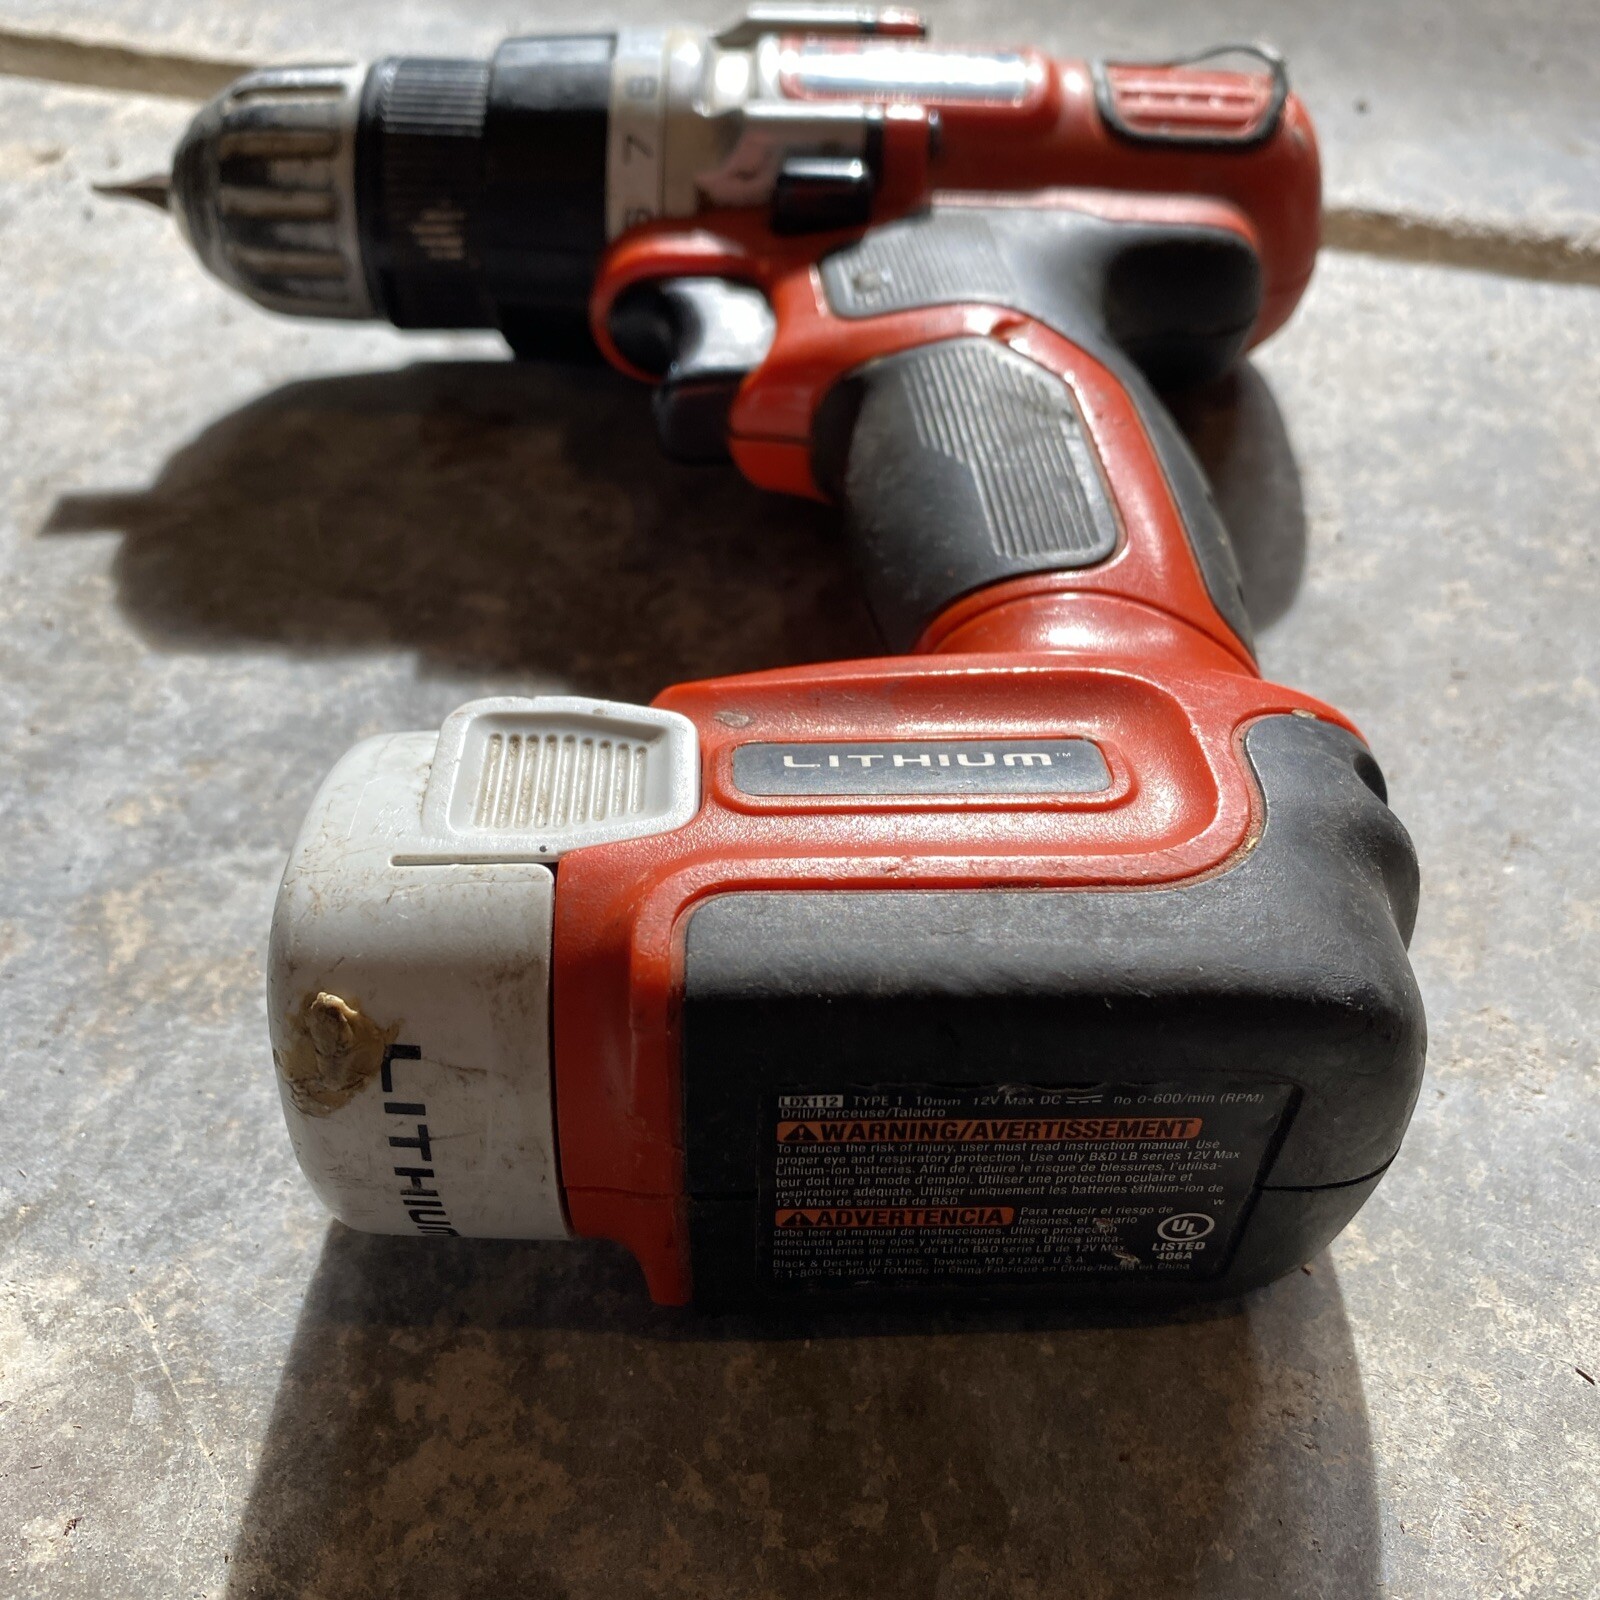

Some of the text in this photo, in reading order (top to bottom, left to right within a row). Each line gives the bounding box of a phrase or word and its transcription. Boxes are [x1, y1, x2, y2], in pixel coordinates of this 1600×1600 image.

[622, 132, 655, 167] 7
[783, 752, 1052, 768] LITHIUM
[779, 1095, 842, 1108] LDX112
[854, 1096, 889, 1107] TYPE
[897, 1096, 902, 1106] 1
[917, 1096, 961, 1106] 10mm
[974, 1095, 1000, 1106] 12V
[1004, 1095, 1036, 1105] Max
[1041, 1095, 1062, 1105] DC
[1220, 1093, 1264, 1104] (RPM)
[781, 1107, 946, 1119] Drill/Perceuse/Taladro
[821, 1121, 1195, 1141] WARNING/AVERTISSEMENT
[776, 1143, 790, 1153] To
[796, 1143, 840, 1153] reduce
[846, 1143, 866, 1152] the
[870, 1143, 895, 1152] risk
[901, 1142, 913, 1152] of
[961, 1144, 990, 1152] user
[994, 1141, 1027, 1151] must
[1031, 1141, 1060, 1151] read
[1065, 1141, 1135, 1151] instruction
[1140, 1140, 1190, 1150] manual.
[1196, 1140, 1220, 1150] Use
[776, 1150, 1241, 1166] proper eye and respiratory protection. Use only B&D LB series 12V Max
[776, 1165, 850, 1175] Lithium-ion
[855, 1164, 916, 1174] batteries.
[920, 1164, 946, 1174] Afin
[950, 1164, 965, 1173] de
[1021, 1163, 1031, 1172] le
[1036, 1163, 1075, 1174] risque
[1080, 1162, 1096, 1172] de
[776, 1176, 801, 1187] teur
[806, 1176, 830, 1187] doit
[835, 1176, 855, 1186] lire
[860, 1176, 871, 1186] le
[875, 1175, 911, 1186] mode
[979, 1174, 1024, 1185] Utiliser
[1029, 1176, 1051, 1184] une
[1055, 1173, 1121, 1186] protection
[1125, 1172, 1176, 1183] oculaire
[1180, 1172, 1193, 1182] et
[776, 1188, 850, 1198] respiratoire
[920, 1186, 965, 1196] Utiliser
[970, 1185, 1044, 1197] uniquement
[1049, 1185, 1067, 1194] les
[1071, 1184, 1128, 1194] batteries
[1208, 1183, 1224, 1192] de
[806, 1198, 831, 1207] Max
[836, 1198, 851, 1206] de
[892, 1197, 908, 1206] LB
[911, 1197, 927, 1205] de
[1020, 1205, 1174, 1216] Para reducir el riesgo de
[816, 1209, 1004, 1226] ADVERTENCIA
[1077, 1216, 1088, 1224] el
[774, 1228, 804, 1237] debe
[851, 1227, 896, 1236] manual
[900, 1227, 916, 1235] de
[1010, 1226, 1049, 1234] Utilice
[1171, 1218, 1199, 1236] UL
[836, 1239, 864, 1248] para
[1151, 1241, 1206, 1251] LISTED
[1155, 1251, 1193, 1260] 406A
[773, 1259, 807, 1268] Black
[811, 1259, 819, 1268] &
[823, 1258, 864, 1267] Decker
